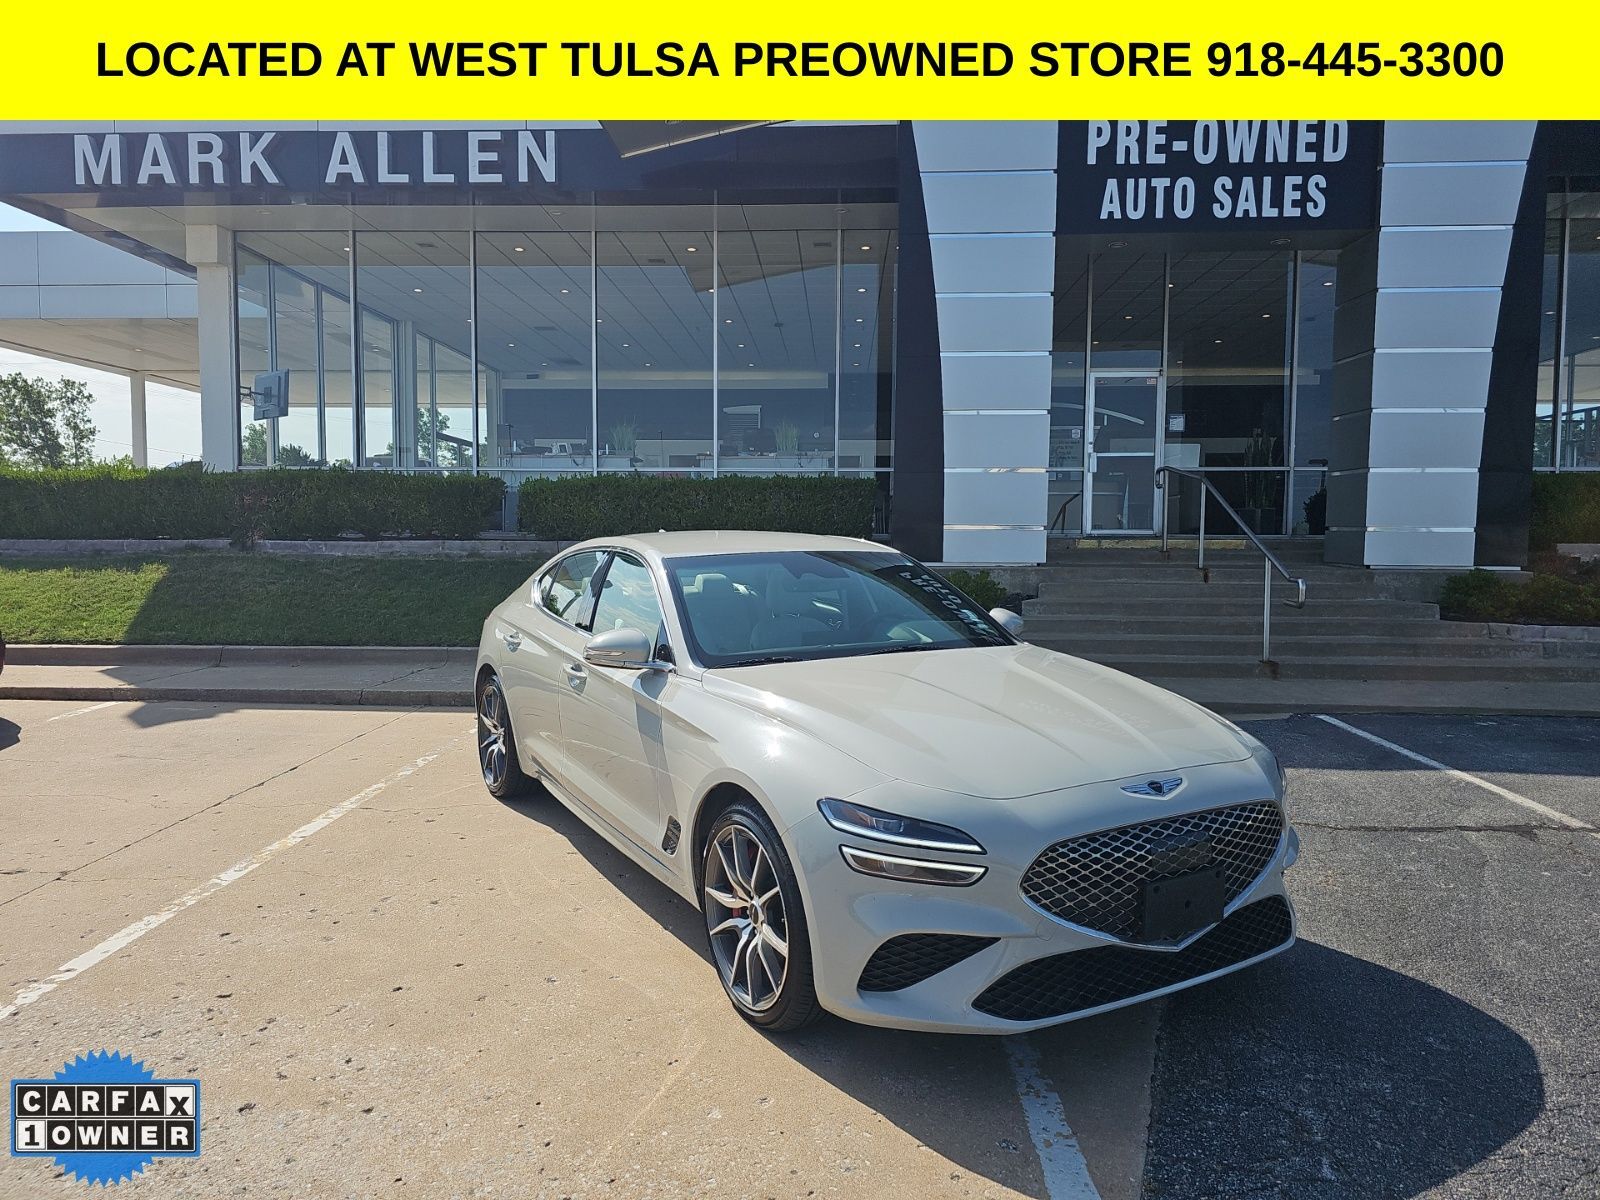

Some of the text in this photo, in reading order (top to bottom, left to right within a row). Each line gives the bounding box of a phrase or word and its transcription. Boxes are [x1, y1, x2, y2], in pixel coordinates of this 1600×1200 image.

[73, 131, 557, 185] MARK ALLEN
[1086, 120, 1348, 165] PRE-OWNED
[1099, 174, 1327, 220] AUTO SALES
